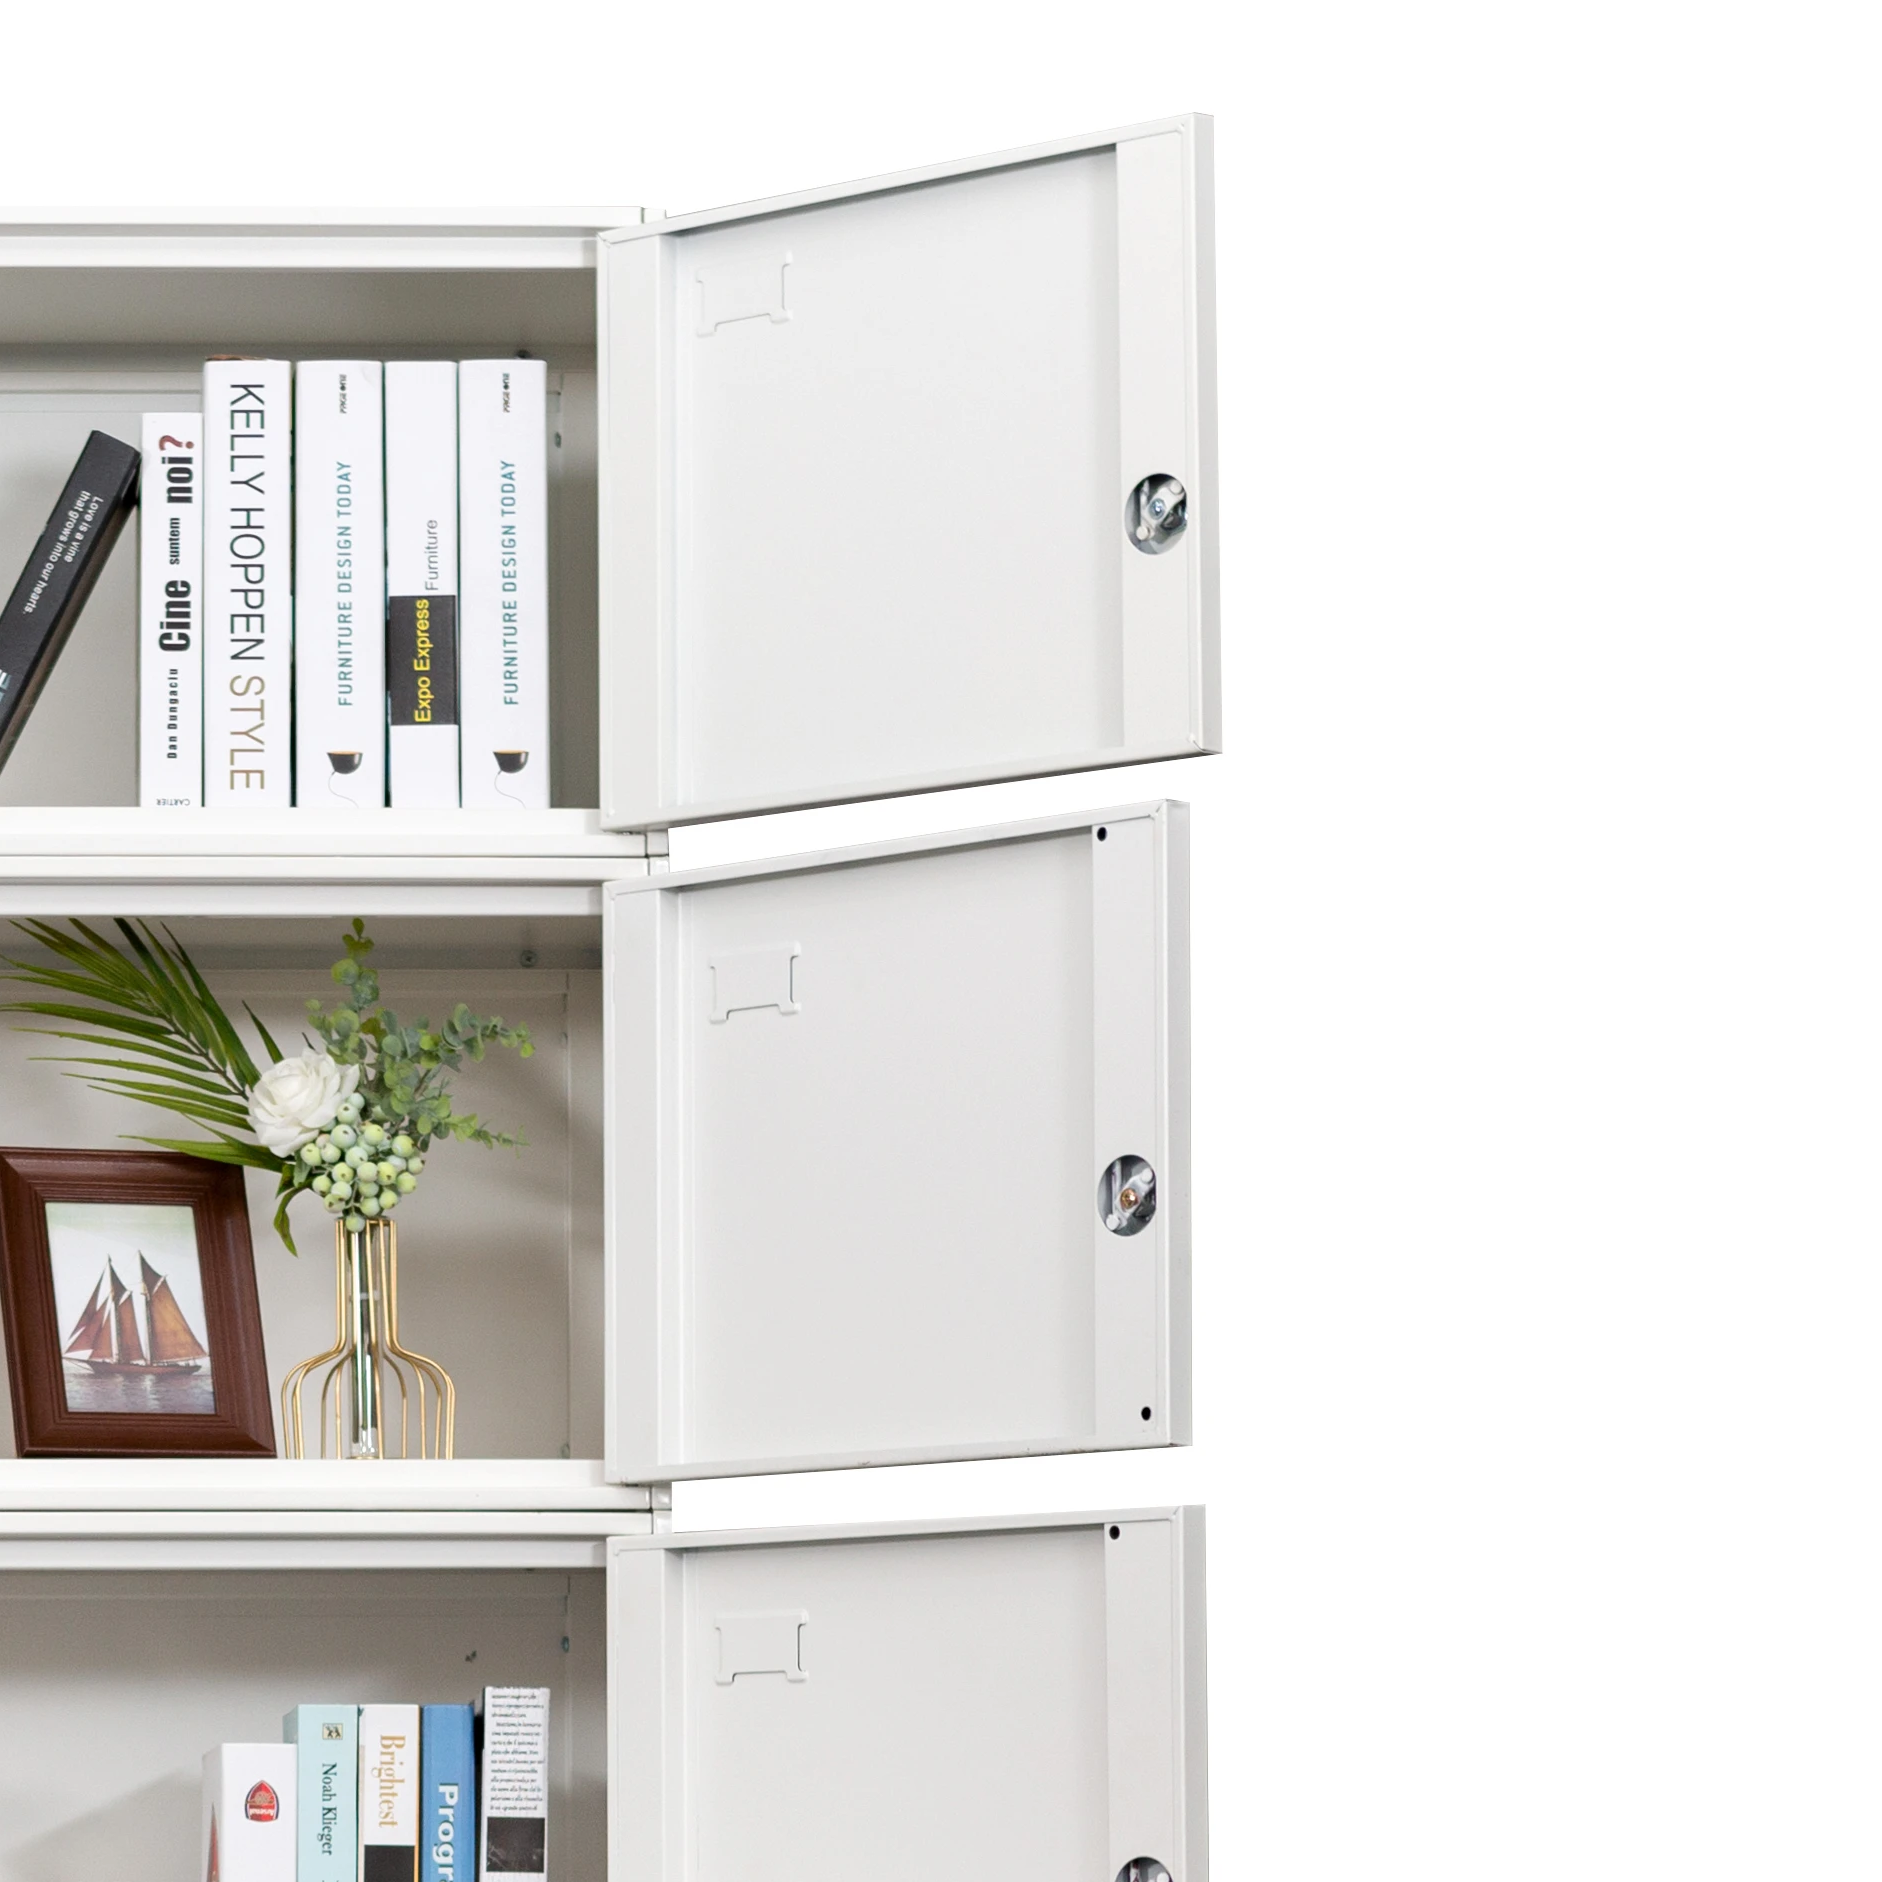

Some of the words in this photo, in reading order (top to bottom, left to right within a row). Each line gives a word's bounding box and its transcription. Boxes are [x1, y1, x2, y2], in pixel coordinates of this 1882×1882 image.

[229, 384, 266, 494] KELLY
[158, 434, 194, 504] noi?
[337, 460, 352, 518] TODAY
[501, 459, 517, 516] TODAY
[59, 510, 79, 542] grows
[74, 490, 91, 512] that
[78, 522, 91, 532] is
[84, 496, 104, 522] Love
[49, 542, 66, 562] into
[64, 541, 80, 563] vine
[75, 532, 84, 540] a
[168, 517, 181, 566] suntem
[337, 525, 352, 592] DESIGN
[425, 519, 439, 591] Furniture
[502, 523, 518, 591] DESIGN
[23, 580, 47, 614] hearts.
[41, 562, 54, 581] our
[229, 507, 266, 661] HOPPEN
[158, 580, 192, 652] Cine
[414, 598, 432, 665] Express
[337, 601, 352, 706] FURNITURE
[503, 600, 519, 705] FURNITURE
[167, 668, 178, 730] Dungaciu
[414, 669, 432, 723] Expo
[167, 732, 178, 759] Dan
[229, 674, 266, 791] STYLE
[156, 798, 191, 807] CARTIER
[322, 1763, 337, 1801] Noah
[371, 1734, 406, 1829] Brightest
[317, 1804, 338, 1857] Klieger
